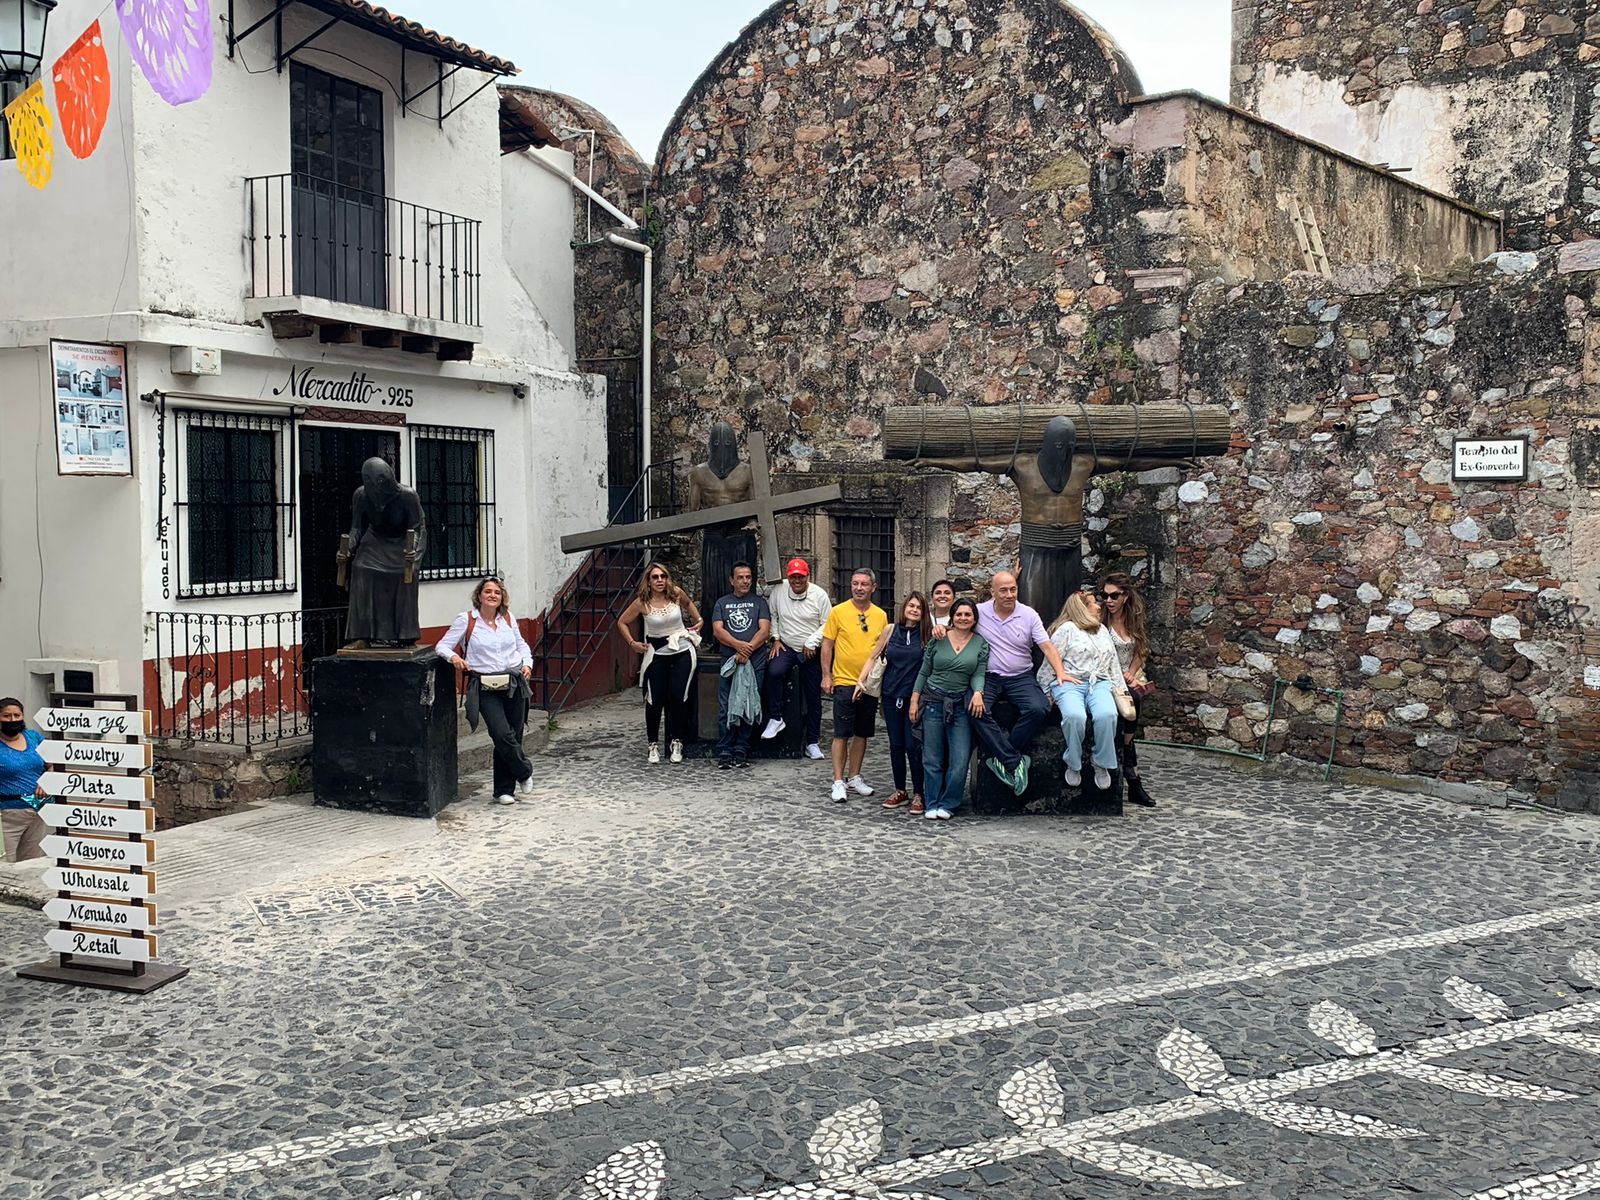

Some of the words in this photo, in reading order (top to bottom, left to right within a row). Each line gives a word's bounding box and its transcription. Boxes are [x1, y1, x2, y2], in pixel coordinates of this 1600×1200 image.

[81, 354, 106, 362] RENTAN
[273, 364, 382, 403] Mercadito
[1459, 446, 1499, 457] Templo
[1501, 445, 1518, 455] del
[64, 742, 125, 767] Jewelry
[61, 773, 116, 795] Plata
[65, 807, 117, 828] Silver
[66, 840, 126, 861] Mayoreo
[61, 871, 130, 893] Wholesale
[67, 903, 127, 925] Menudeo
[73, 933, 121, 955] Retail
